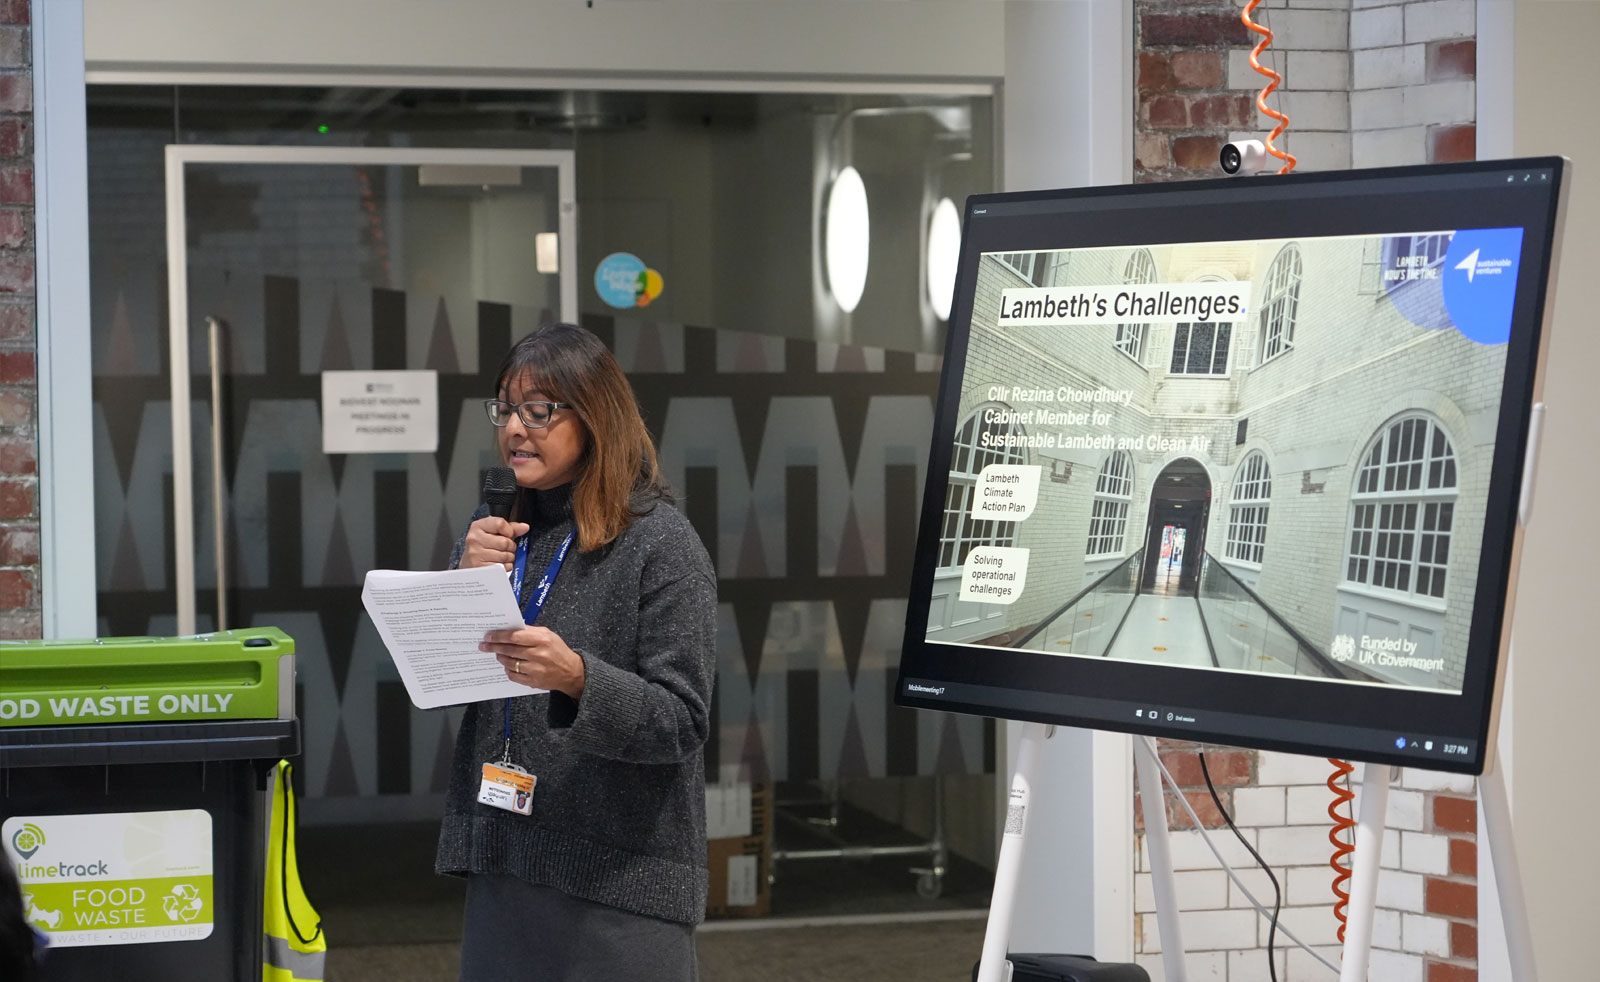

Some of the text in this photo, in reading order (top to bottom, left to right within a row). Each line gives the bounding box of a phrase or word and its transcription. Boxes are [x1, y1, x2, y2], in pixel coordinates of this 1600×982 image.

[1396, 256, 1428, 268] LAMBETH
[1477, 258, 1512, 268] sustainable
[1000, 291, 1246, 321] Lambeth's Challenges.
[988, 386, 1134, 406] Cllr Rezina Chowdhury
[984, 409, 1112, 426] Cabinet Member for
[981, 432, 1212, 452] Sustainable Lambeth and Clean Air
[986, 474, 1020, 483] Lambeth
[984, 487, 1014, 498] Climate
[982, 502, 1026, 512] Action Plan
[974, 554, 1003, 568] Solving
[972, 570, 1016, 581] operational
[536, 582, 551, 606] Lambeth
[970, 584, 1012, 597] challenges
[1360, 636, 1418, 656] Funded by
[1360, 650, 1444, 670] UK Government
[48, 696, 150, 718] WASTE
[158, 694, 234, 714] ONLY
[1444, 744, 1468, 754] 3:27 PM
[18, 860, 108, 878] limetrack
[73, 887, 146, 908] FOOD
[74, 908, 146, 926] WASTE
[154, 928, 205, 938] FUTURE
